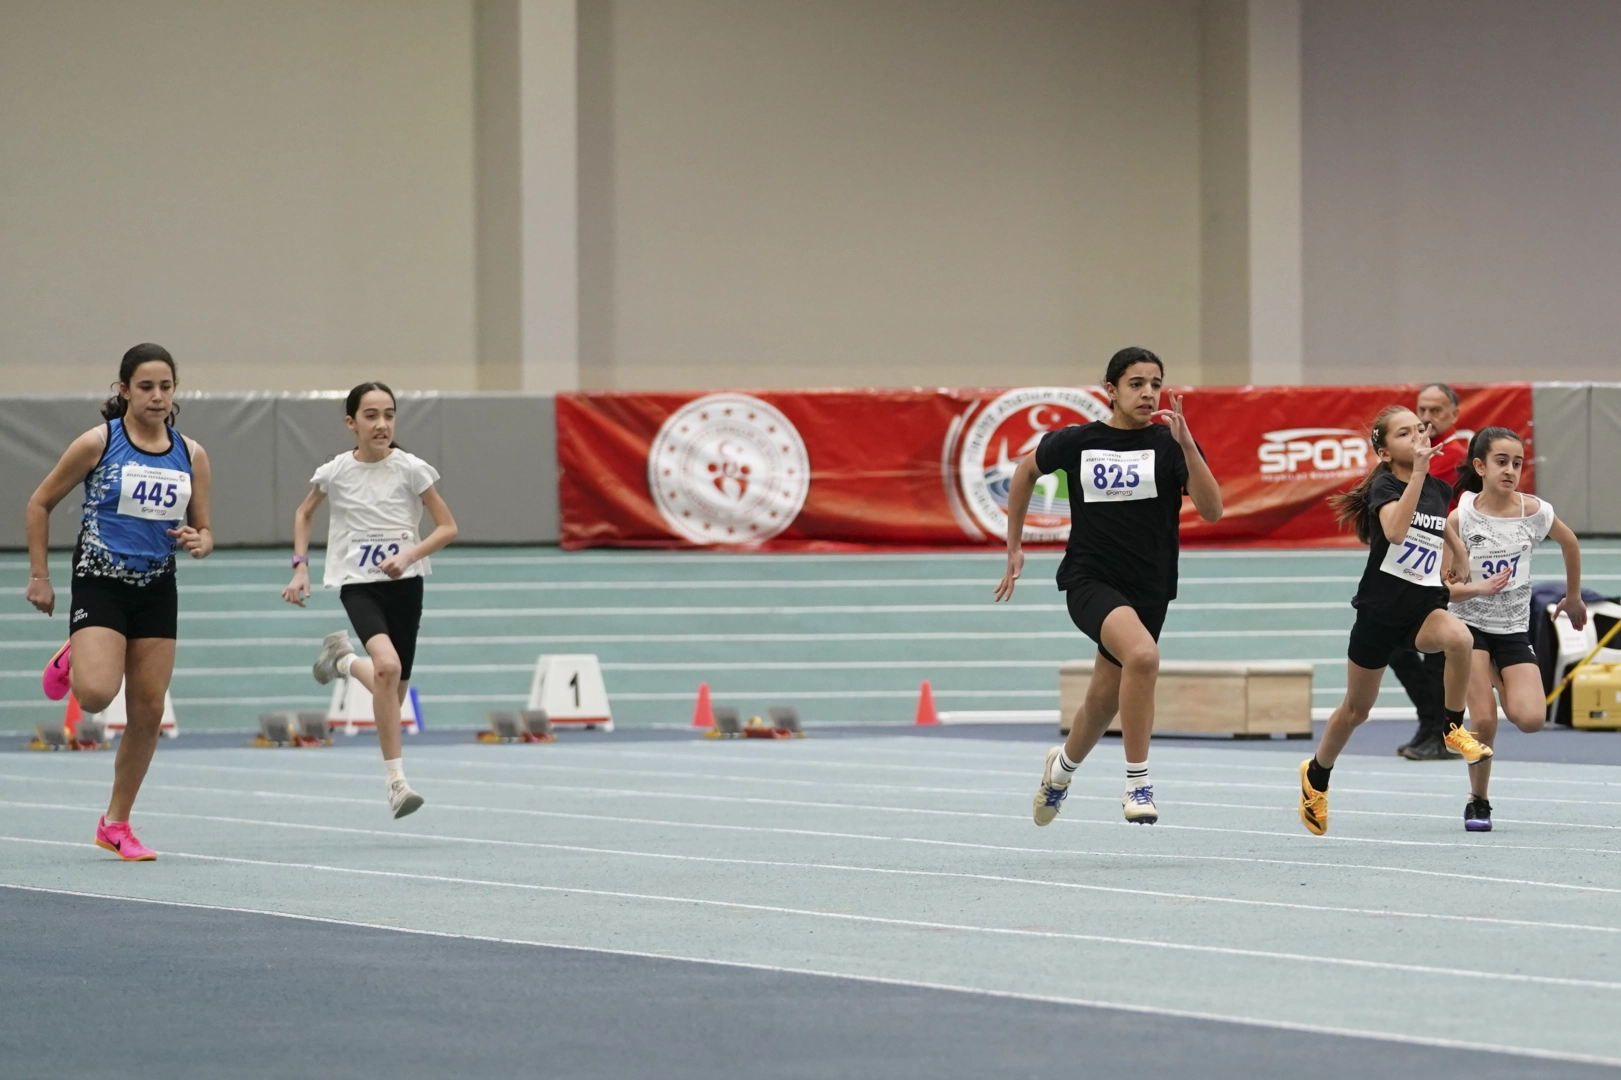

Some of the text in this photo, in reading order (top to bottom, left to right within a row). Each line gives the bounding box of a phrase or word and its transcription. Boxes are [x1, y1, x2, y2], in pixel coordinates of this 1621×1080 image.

[1258, 437, 1368, 474] SPOR
[1093, 464, 1140, 490] 825
[132, 481, 177, 508] 445
[1397, 541, 1437, 574] 770
[570, 672, 580, 708] 1
